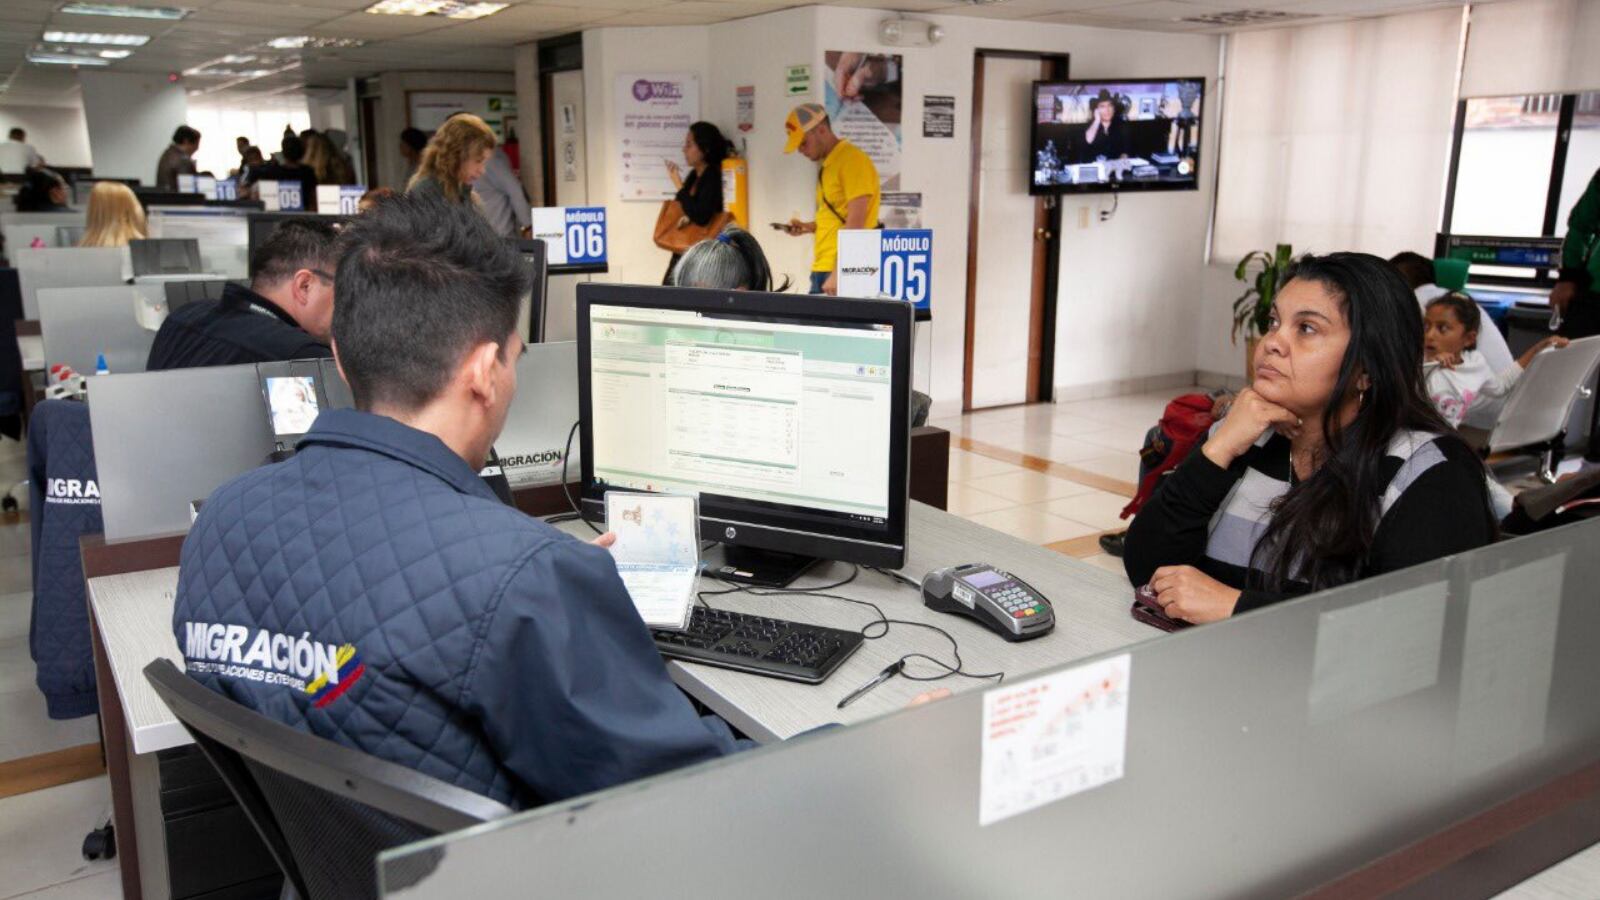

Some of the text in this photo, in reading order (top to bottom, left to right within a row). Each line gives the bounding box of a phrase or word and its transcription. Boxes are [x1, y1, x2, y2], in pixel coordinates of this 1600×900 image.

[280, 191, 300, 209] 09
[566, 210, 604, 223] MÓDULO
[568, 223, 604, 258] 06
[882, 235, 929, 252] MÓDULO
[883, 254, 926, 303] 05
[185, 622, 339, 684] MIGRACIÓN
